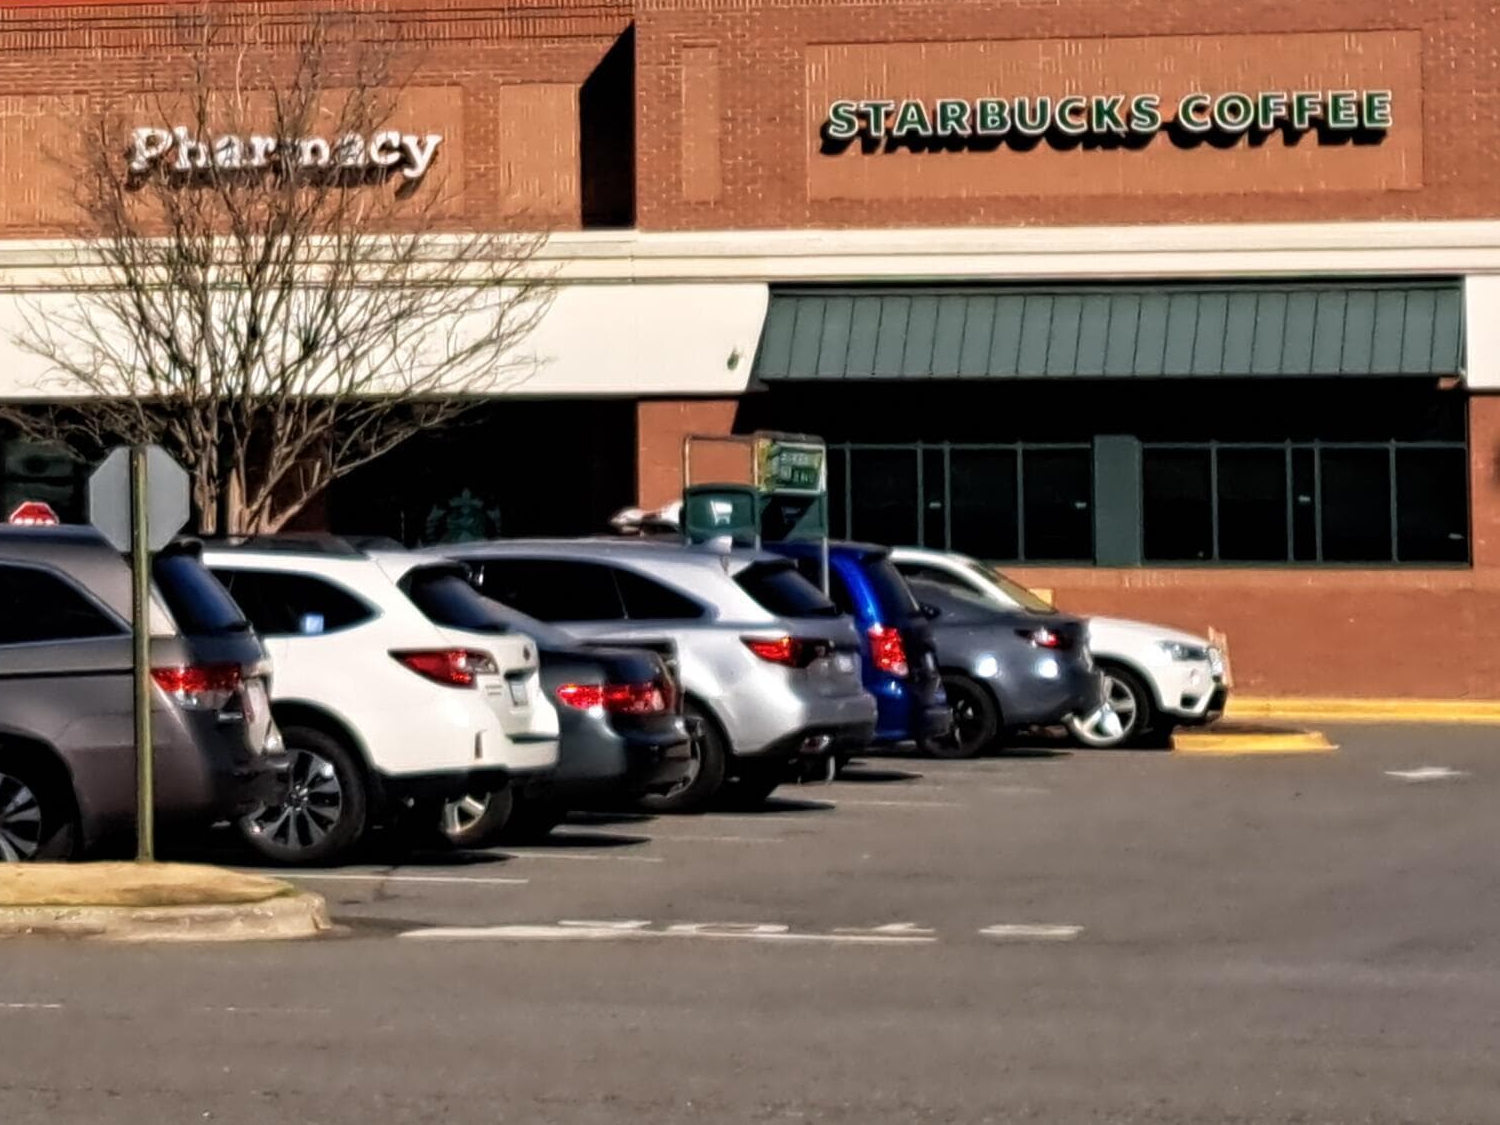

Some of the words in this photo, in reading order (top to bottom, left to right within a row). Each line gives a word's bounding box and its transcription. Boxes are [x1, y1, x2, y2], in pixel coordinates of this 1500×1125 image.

[828, 94, 1162, 138] STARBUCKS
[1177, 89, 1392, 131] COFFEE
[130, 125, 442, 178] Pharmacy
